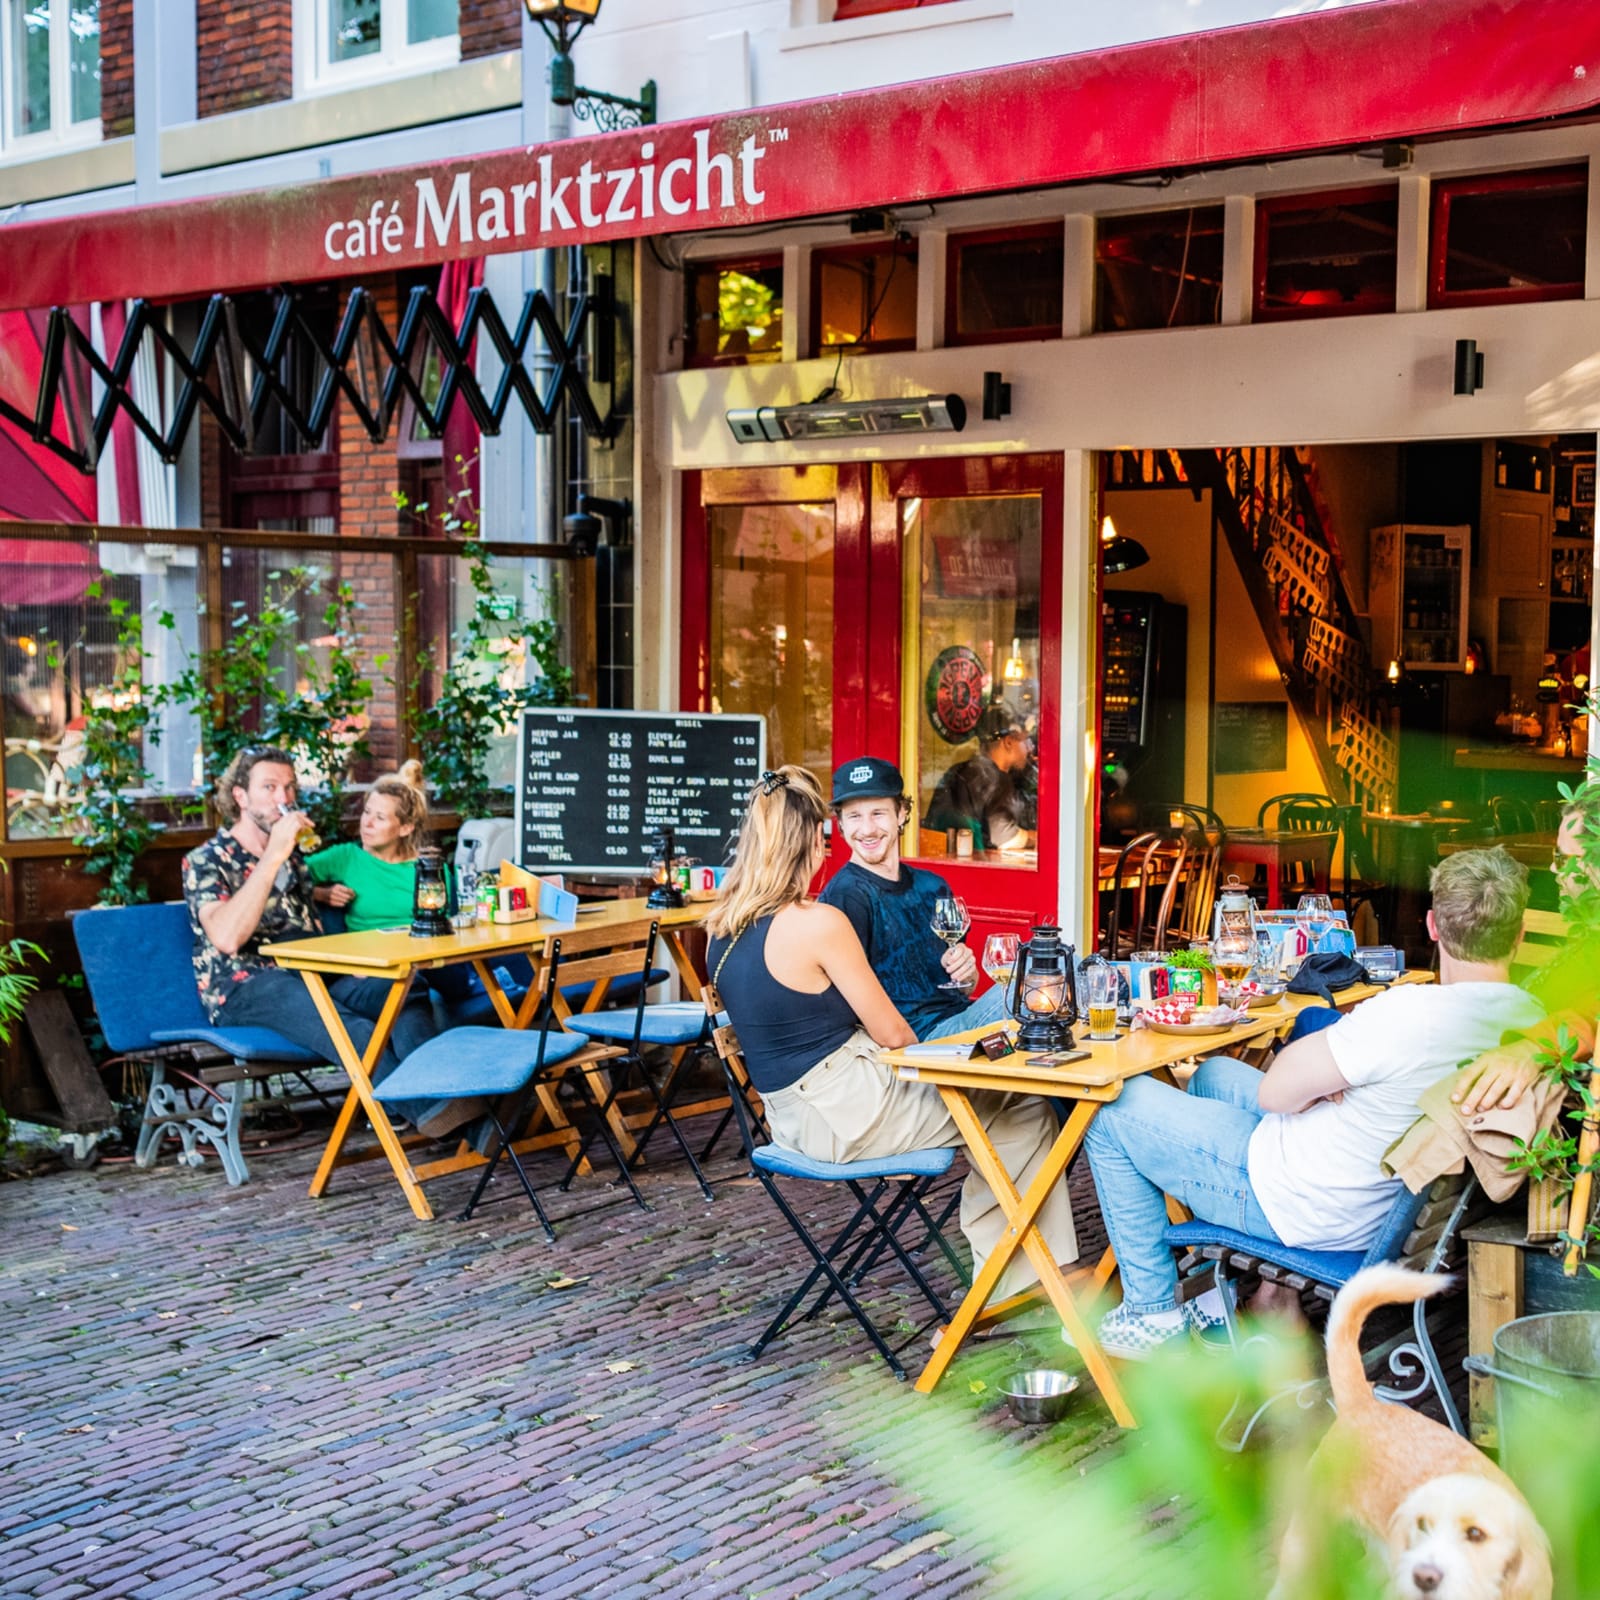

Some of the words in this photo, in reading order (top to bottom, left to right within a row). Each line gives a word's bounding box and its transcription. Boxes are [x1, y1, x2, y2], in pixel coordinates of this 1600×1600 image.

[324, 200, 404, 260] café
[414, 128, 765, 249] Marktzicht
[528, 772, 552, 780] LEFFE
[526, 786, 537, 794] LA
[542, 786, 576, 796] CHOUFFE
